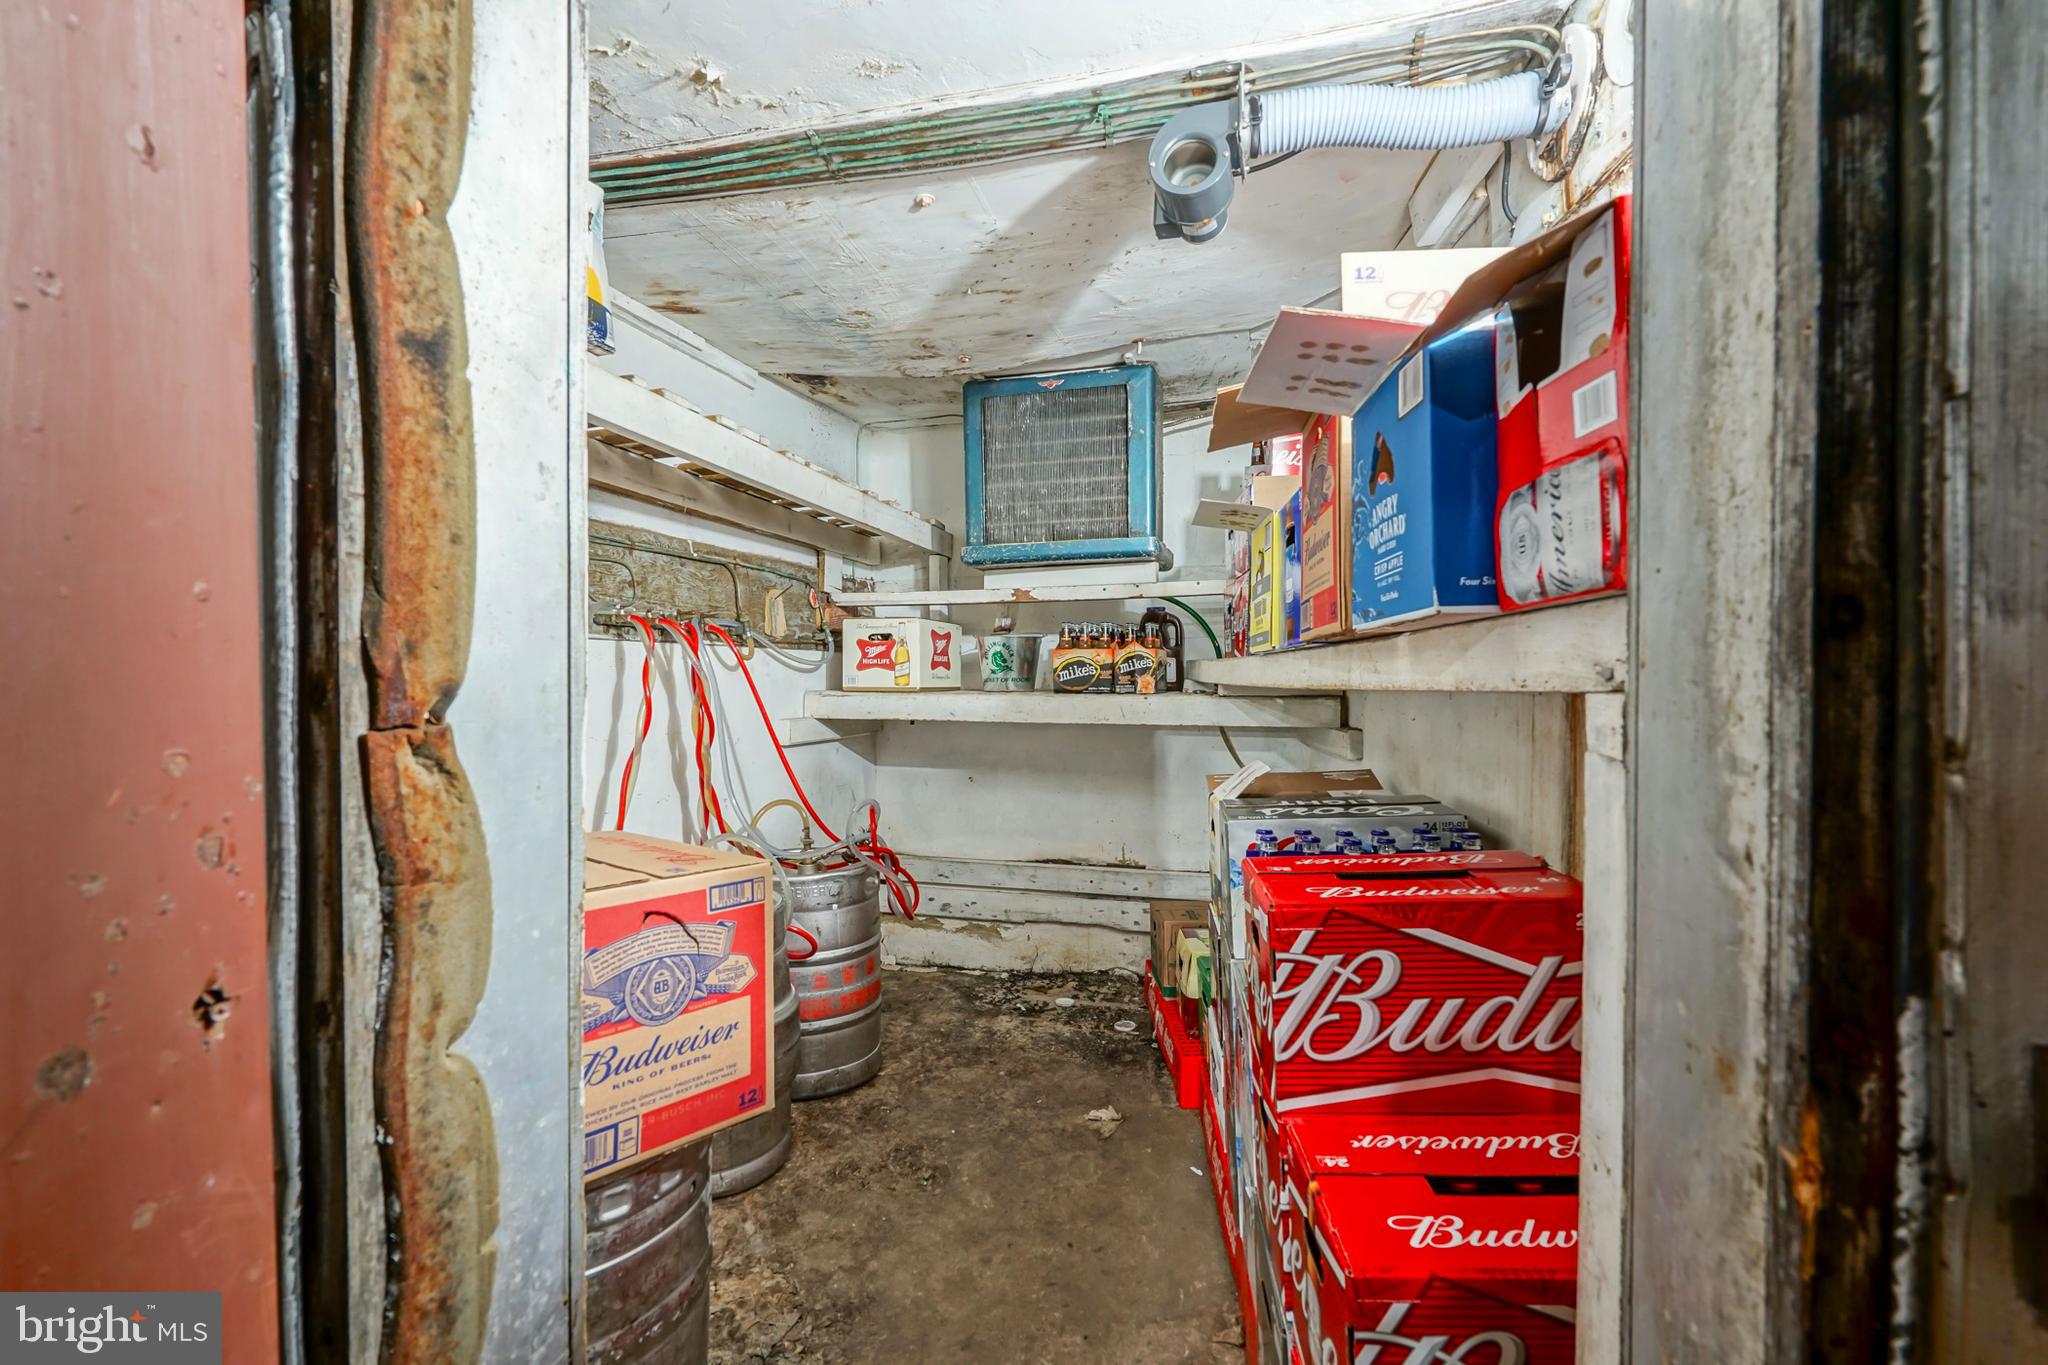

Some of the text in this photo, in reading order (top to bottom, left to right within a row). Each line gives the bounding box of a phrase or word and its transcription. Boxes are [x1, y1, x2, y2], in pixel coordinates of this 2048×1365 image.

[1355, 266, 1377, 281] 12
[1372, 493, 1399, 528] ANGRY
[1368, 513, 1407, 550] ORCHARD
[1459, 576, 1481, 586] Four
[877, 657, 890, 665] LIFE
[1119, 656, 1153, 674] mike's
[1059, 664, 1097, 682] mike's
[1256, 804, 1435, 818] Coors
[1294, 852, 1503, 867] Budweiser
[1304, 884, 1543, 899] Budweiser
[583, 1020, 742, 1088] Budweiser
[611, 1075, 646, 1091] KING
[649, 1068, 665, 1079] OF
[738, 1088, 758, 1107] 12
[1350, 1132, 1581, 1159] Budweiser
[1386, 1214, 1578, 1249] Budw
